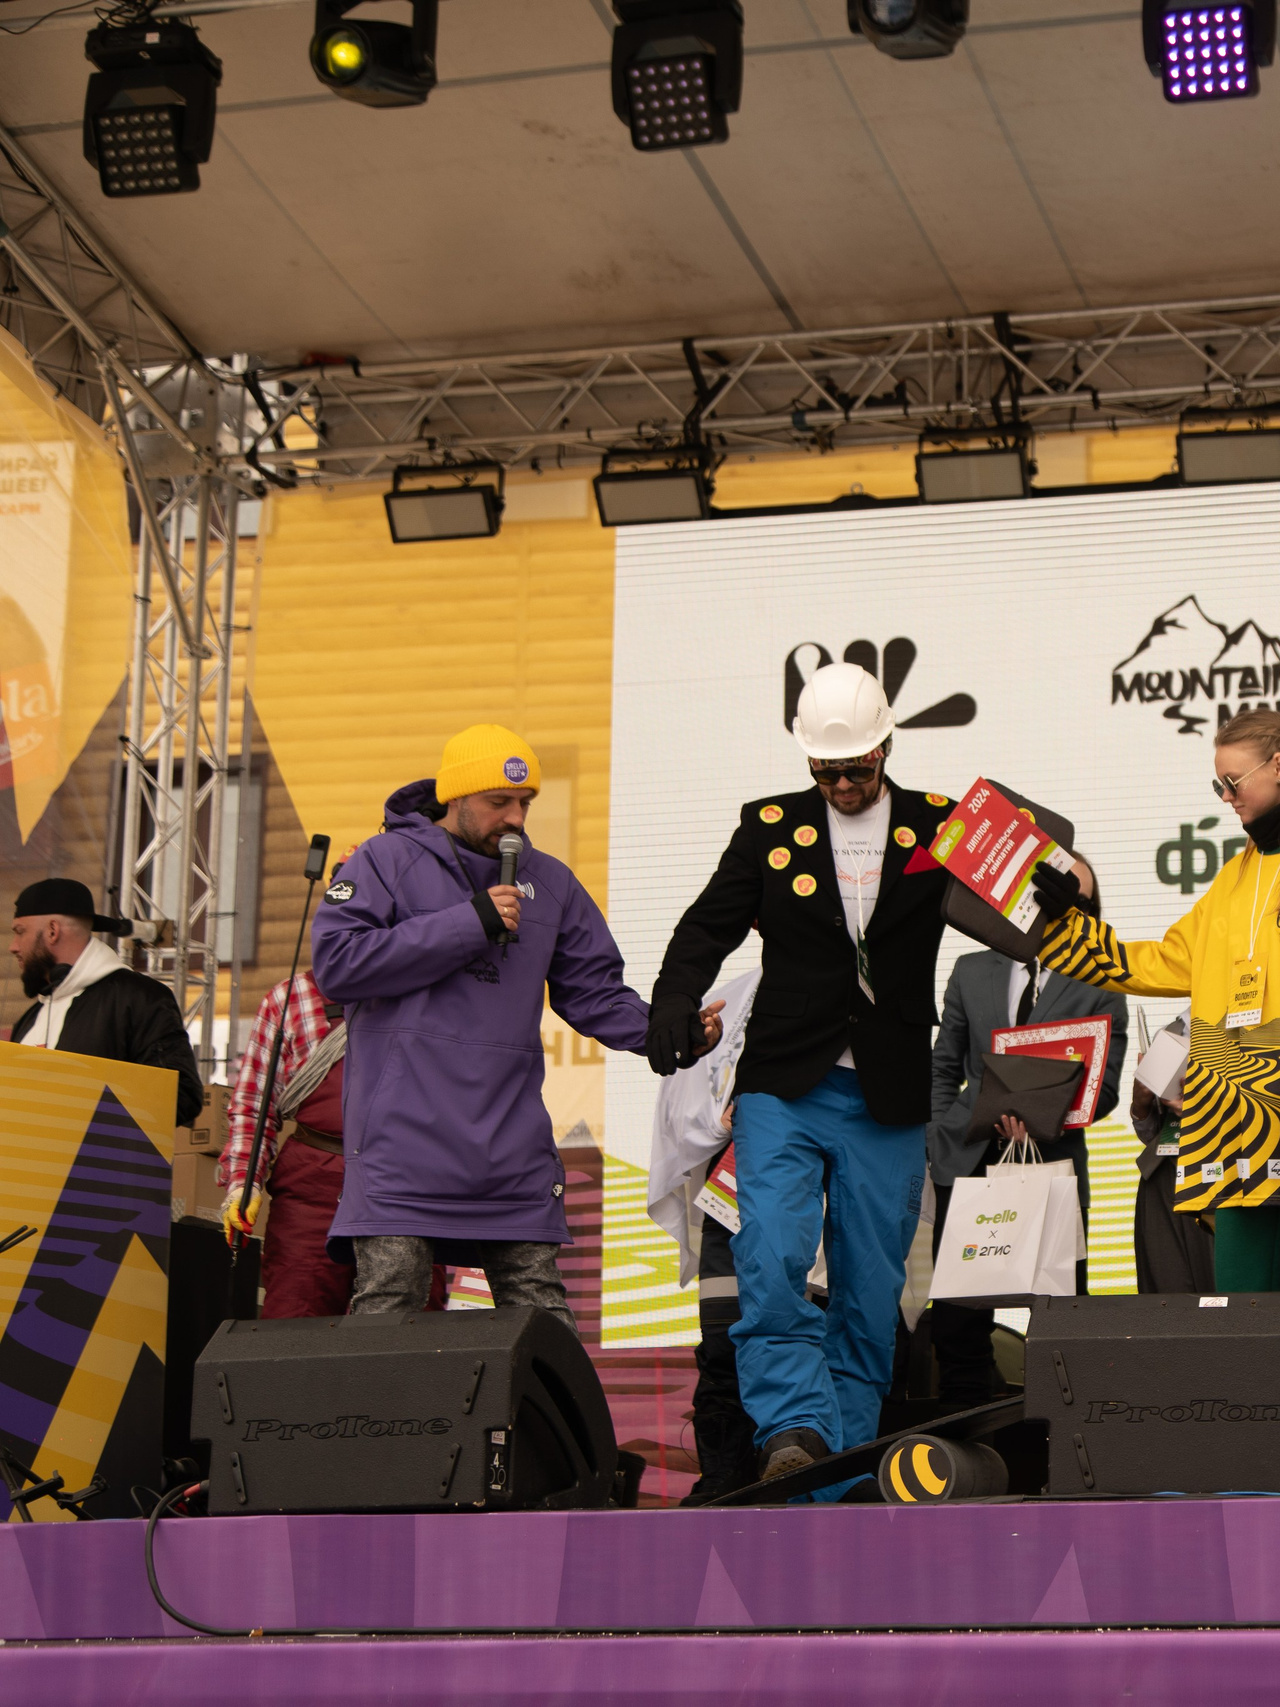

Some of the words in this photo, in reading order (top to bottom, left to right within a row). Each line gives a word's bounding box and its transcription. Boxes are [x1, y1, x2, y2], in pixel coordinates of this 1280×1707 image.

[968, 788, 991, 815] 2024
[965, 818, 992, 854] ДИПЛОМ
[971, 857, 988, 883] Приз
[985, 819, 1020, 865] зрительских
[989, 839, 1016, 876] симпатий
[979, 1244, 1012, 1257] 2ГИС
[242, 1415, 453, 1442] ProTone
